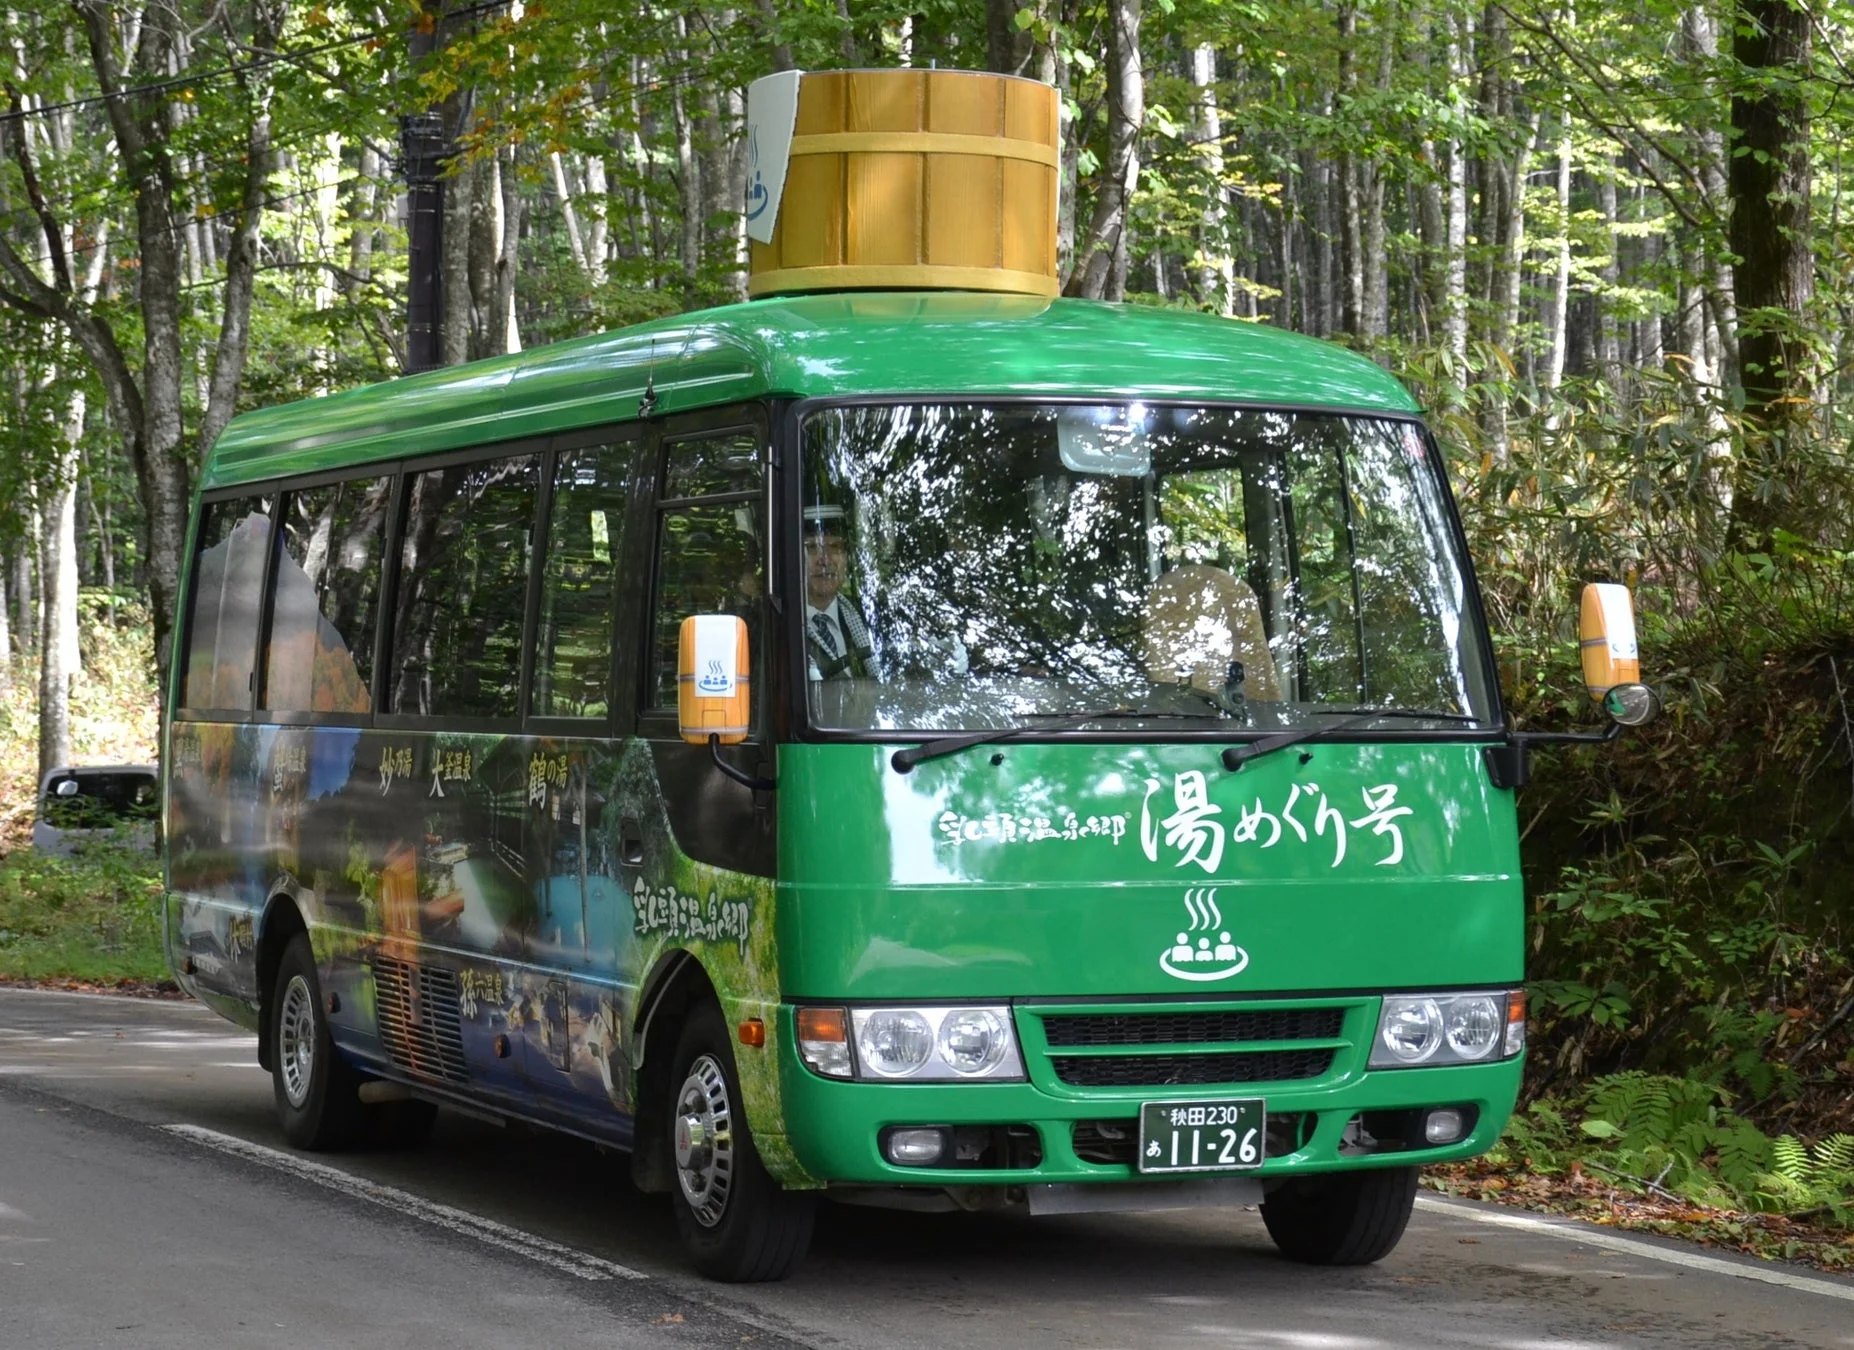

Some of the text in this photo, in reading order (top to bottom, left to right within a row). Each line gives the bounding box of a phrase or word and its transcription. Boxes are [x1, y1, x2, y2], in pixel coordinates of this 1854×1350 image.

[429, 749, 472, 798] 大釜温泉
[528, 751, 568, 810] 鶴の湯
[937, 769, 1414, 873] 乳頭温泉郷 湯めぐり号
[633, 875, 749, 957] 乳頭温泉郷
[1145, 1127, 1258, 1166] あ 11-26
